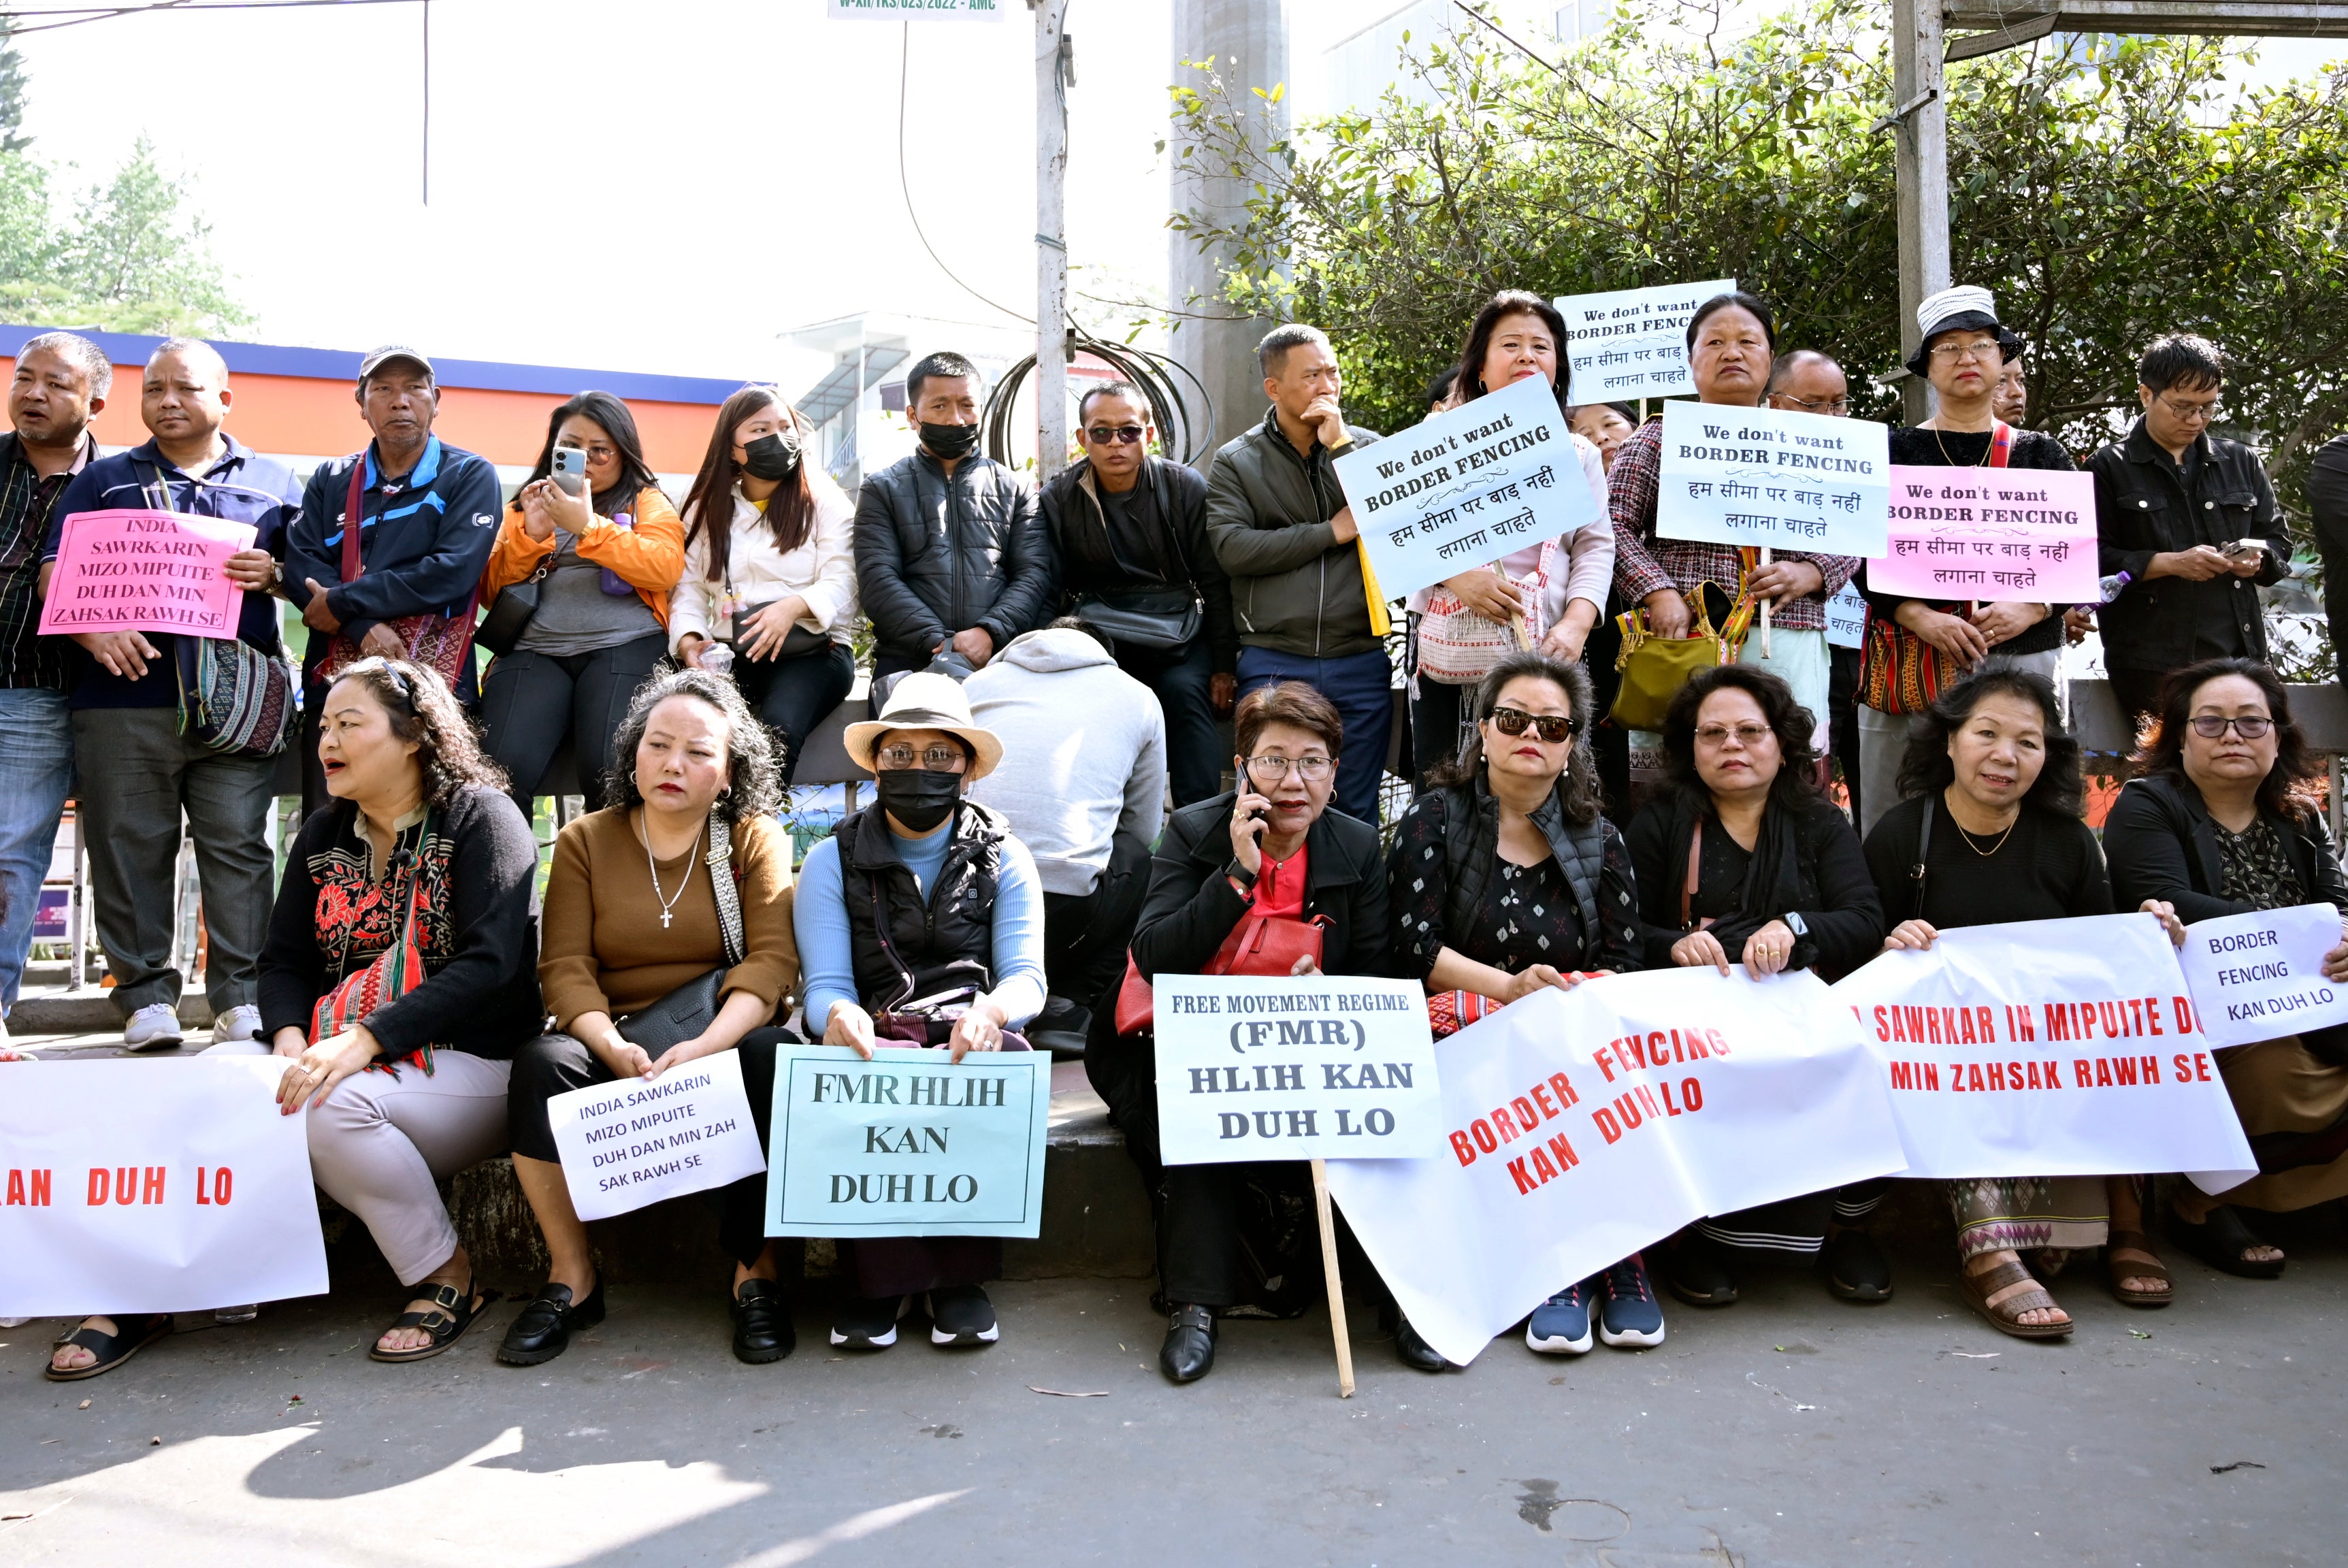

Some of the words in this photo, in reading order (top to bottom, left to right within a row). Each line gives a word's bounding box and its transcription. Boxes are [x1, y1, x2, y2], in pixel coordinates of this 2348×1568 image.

[968, 0, 996, 10] AMC
[1584, 310, 1605, 321] We
[1612, 303, 1650, 319] don't
[1657, 299, 1697, 312] want
[1567, 323, 1636, 340] BORDER
[1642, 317, 1695, 332] FENC
[1573, 357, 1593, 370] हम
[1597, 350, 1629, 366] सीमा
[1634, 350, 1651, 361] पर
[1657, 347, 1681, 358] बाड़
[1603, 374, 1644, 388] लगाना
[1650, 366, 1686, 384] चाहते
[1376, 461, 1405, 479] We
[1412, 436, 1458, 466] don't
[1463, 413, 1513, 443] want
[1703, 425, 1729, 439] We
[1738, 427, 1787, 443] don't
[1795, 436, 1843, 450] want
[1365, 467, 1452, 512] BORDER
[1454, 425, 1550, 475] FENCING
[1679, 446, 1769, 463] BORDER
[1777, 452, 1872, 474] FENCING
[1388, 525, 1415, 546] हम
[1418, 508, 1457, 533] सीमा
[1460, 497, 1484, 514] पर
[1486, 483, 1520, 504] बाड़
[1523, 466, 1555, 489] नहीं
[1688, 483, 1713, 499] हम
[1719, 480, 1759, 499] सीमा
[1765, 488, 1787, 502] पर
[1793, 491, 1824, 509] बाड़
[1831, 492, 1861, 513] नहीं
[1906, 485, 1932, 498] We
[1941, 487, 1989, 500] don't
[1998, 490, 2047, 502] want
[127, 520, 178, 534] INDIA
[1725, 514, 1778, 530] लगाना
[1784, 517, 1827, 538] चाहते
[1888, 506, 1973, 521] BORDER
[1981, 509, 2078, 524] FENCING
[1436, 529, 1487, 559] लगाना
[1490, 506, 1535, 536] चाहते
[91, 541, 208, 557] SAWRKARIN
[1895, 540, 1920, 556] हम
[1926, 537, 1966, 555] सीमा
[1972, 543, 1993, 555] पर
[2000, 544, 2031, 560] बाड़
[2039, 541, 2069, 562] नहीं
[78, 563, 127, 576] MIZO
[131, 563, 214, 581] MIPUITE
[1933, 570, 1986, 583] लगाना
[1992, 568, 2036, 589] चाहते
[77, 585, 116, 599] DUH
[121, 585, 160, 598] DAN
[165, 585, 206, 602] MIN
[54, 608, 130, 623] ZAHSAK
[135, 607, 193, 623] RAWH
[198, 613, 222, 626] SE
[2209, 930, 2278, 953] BORDER
[2218, 962, 2288, 986] FENCING
[1173, 996, 1220, 1013] FREE
[1227, 994, 1331, 1013] MOVEMENT
[1337, 995, 1409, 1011] REGIME
[2228, 1001, 2265, 1021] KAN
[2268, 994, 2308, 1013] DUH
[2310, 989, 2333, 1004] LO
[1874, 1004, 1996, 1045] SAWRKAR
[2006, 1004, 2035, 1042] IN
[2044, 998, 2164, 1041] MIPUITE
[2172, 996, 2204, 1034] D
[1230, 1019, 1365, 1054] (FMR)
[1188, 1064, 1305, 1094] HLIH
[1321, 1063, 1414, 1090] KAN
[1890, 1061, 1939, 1091] MIN
[1950, 1061, 2062, 1092] ZAHSAK
[2074, 1056, 2161, 1088] RAWH
[2174, 1053, 2212, 1083] SE
[580, 1098, 624, 1120] INDIA
[627, 1074, 711, 1106] SAWKARIN
[811, 1073, 901, 1105] FMR
[907, 1076, 1008, 1107] HLIH
[1449, 1072, 1580, 1167] BORDER
[1593, 1028, 1731, 1083] FENCING
[586, 1124, 627, 1144] MIZO
[632, 1104, 696, 1131] MIPUITE
[1218, 1110, 1320, 1139] DUH
[1335, 1108, 1395, 1136] LO
[1507, 1132, 1580, 1196] KAN
[1592, 1084, 1661, 1145] DUH
[1661, 1077, 1703, 1117] LO
[593, 1149, 627, 1167] DUH
[631, 1138, 665, 1158] DAN
[669, 1129, 701, 1147] MIN
[704, 1119, 736, 1138] ZAH
[862, 1126, 951, 1154] KAN
[0, 1169, 52, 1207] AN
[87, 1166, 166, 1206] DUH
[197, 1166, 233, 1206] LO
[600, 1174, 629, 1192] SAK
[632, 1160, 681, 1183] RAWH
[685, 1155, 702, 1168] SE
[828, 1175, 916, 1203] DUH
[922, 1175, 978, 1203] LO
